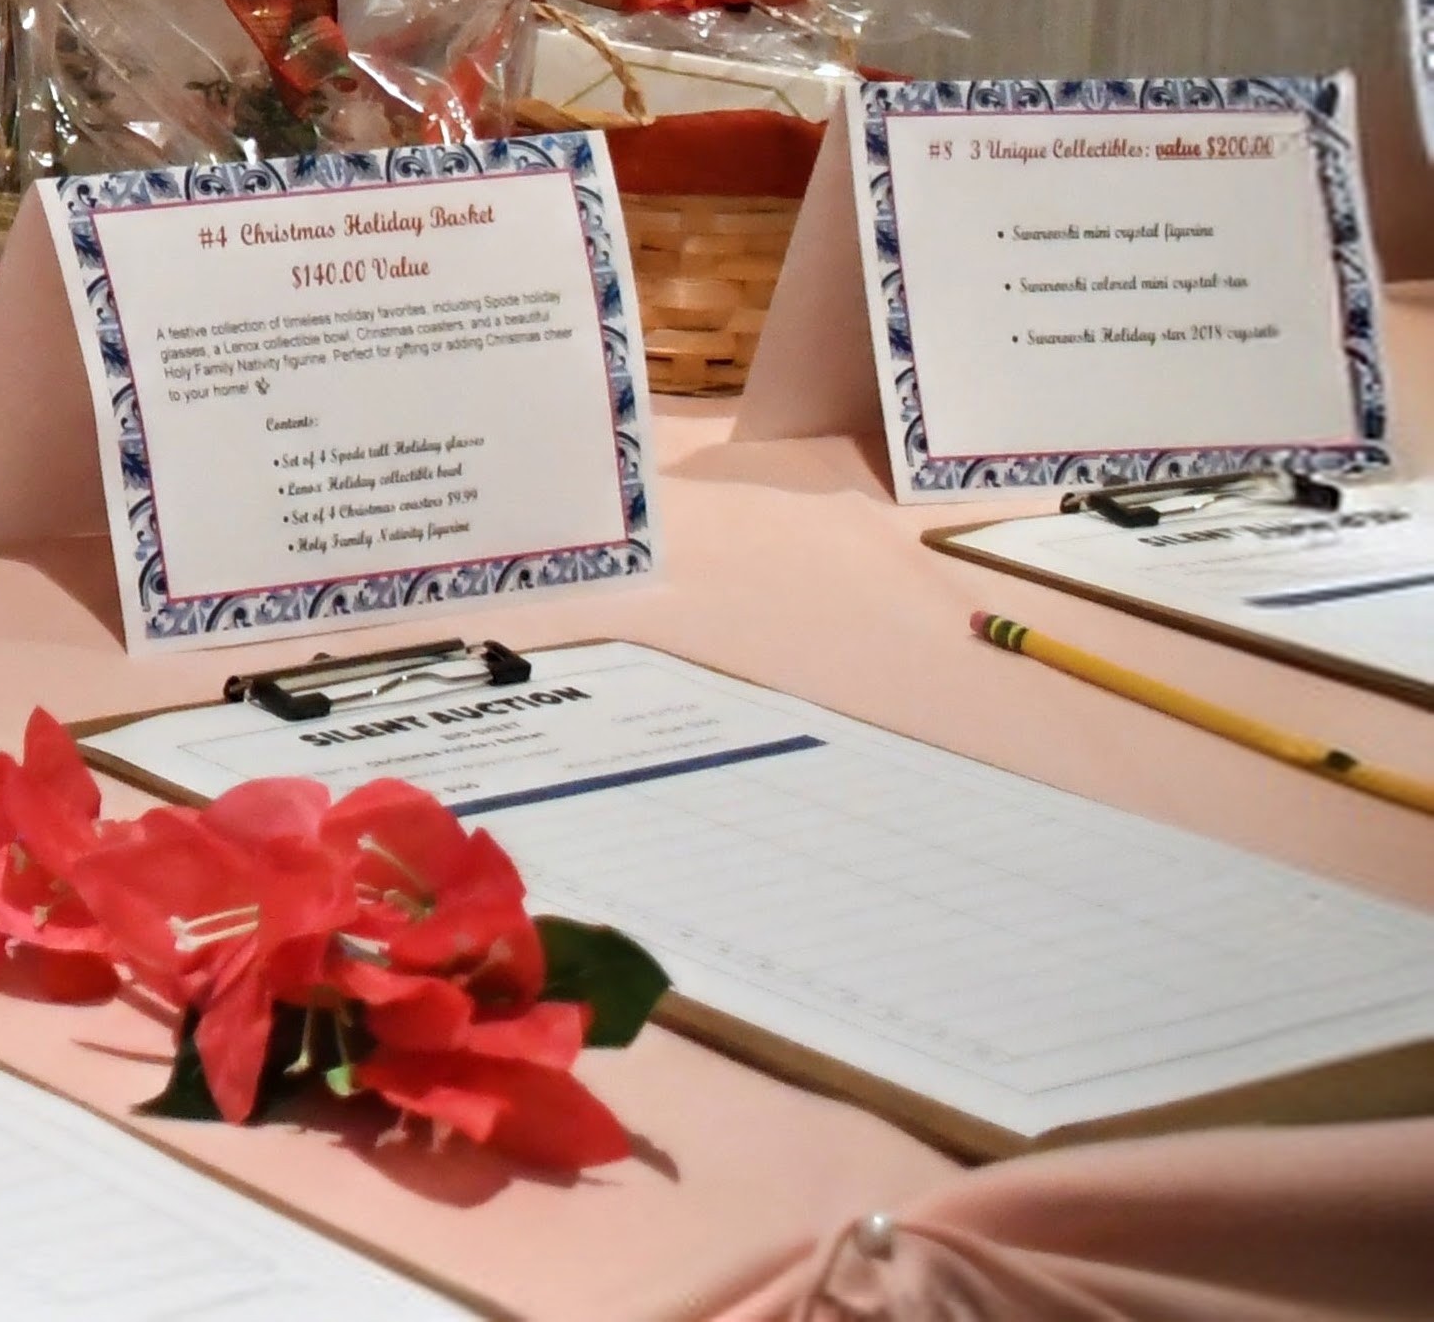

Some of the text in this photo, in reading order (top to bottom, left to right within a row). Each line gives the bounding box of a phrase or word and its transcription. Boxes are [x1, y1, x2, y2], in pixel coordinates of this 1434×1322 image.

[970, 140, 981, 159] 3
[987, 140, 1047, 164] Unique
[1053, 138, 1149, 159] Collectibles:
[1155, 137, 1202, 159] value
[1206, 136, 1275, 158] $200.00
[198, 204, 495, 249] #4 Christmas Holiday Basket
[292, 256, 430, 290] $140.00 Value
[211, 320, 267, 336] collection
[299, 715, 428, 748] SILENT
[427, 686, 592, 725] AUCTION
